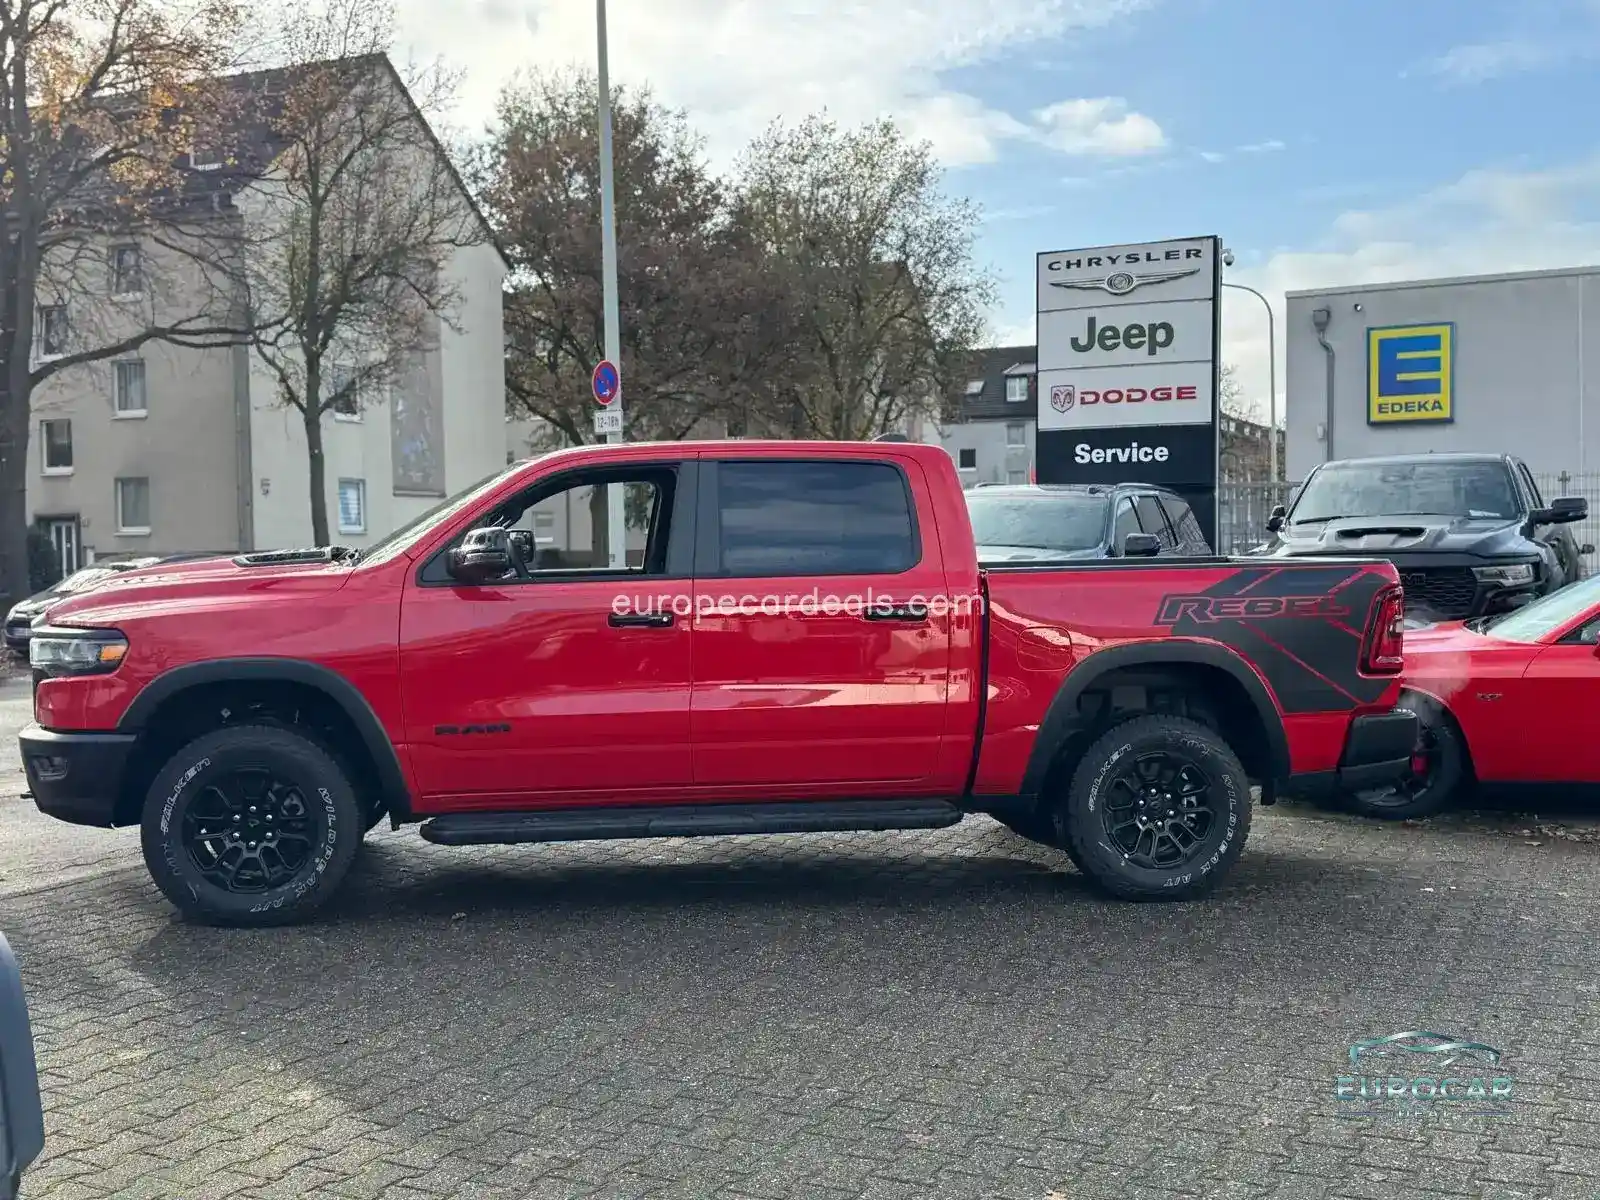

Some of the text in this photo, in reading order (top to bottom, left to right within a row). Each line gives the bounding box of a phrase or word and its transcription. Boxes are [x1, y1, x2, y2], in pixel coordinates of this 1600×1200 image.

[1048, 248, 1203, 271] CHRYSLER
[1070, 316, 1175, 356] Jeep
[1080, 386, 1197, 405] DODGE
[1377, 400, 1444, 414] EDEKA
[1074, 442, 1169, 464] Service
[1153, 594, 1351, 625] REBEL
[434, 723, 511, 735] RAM
